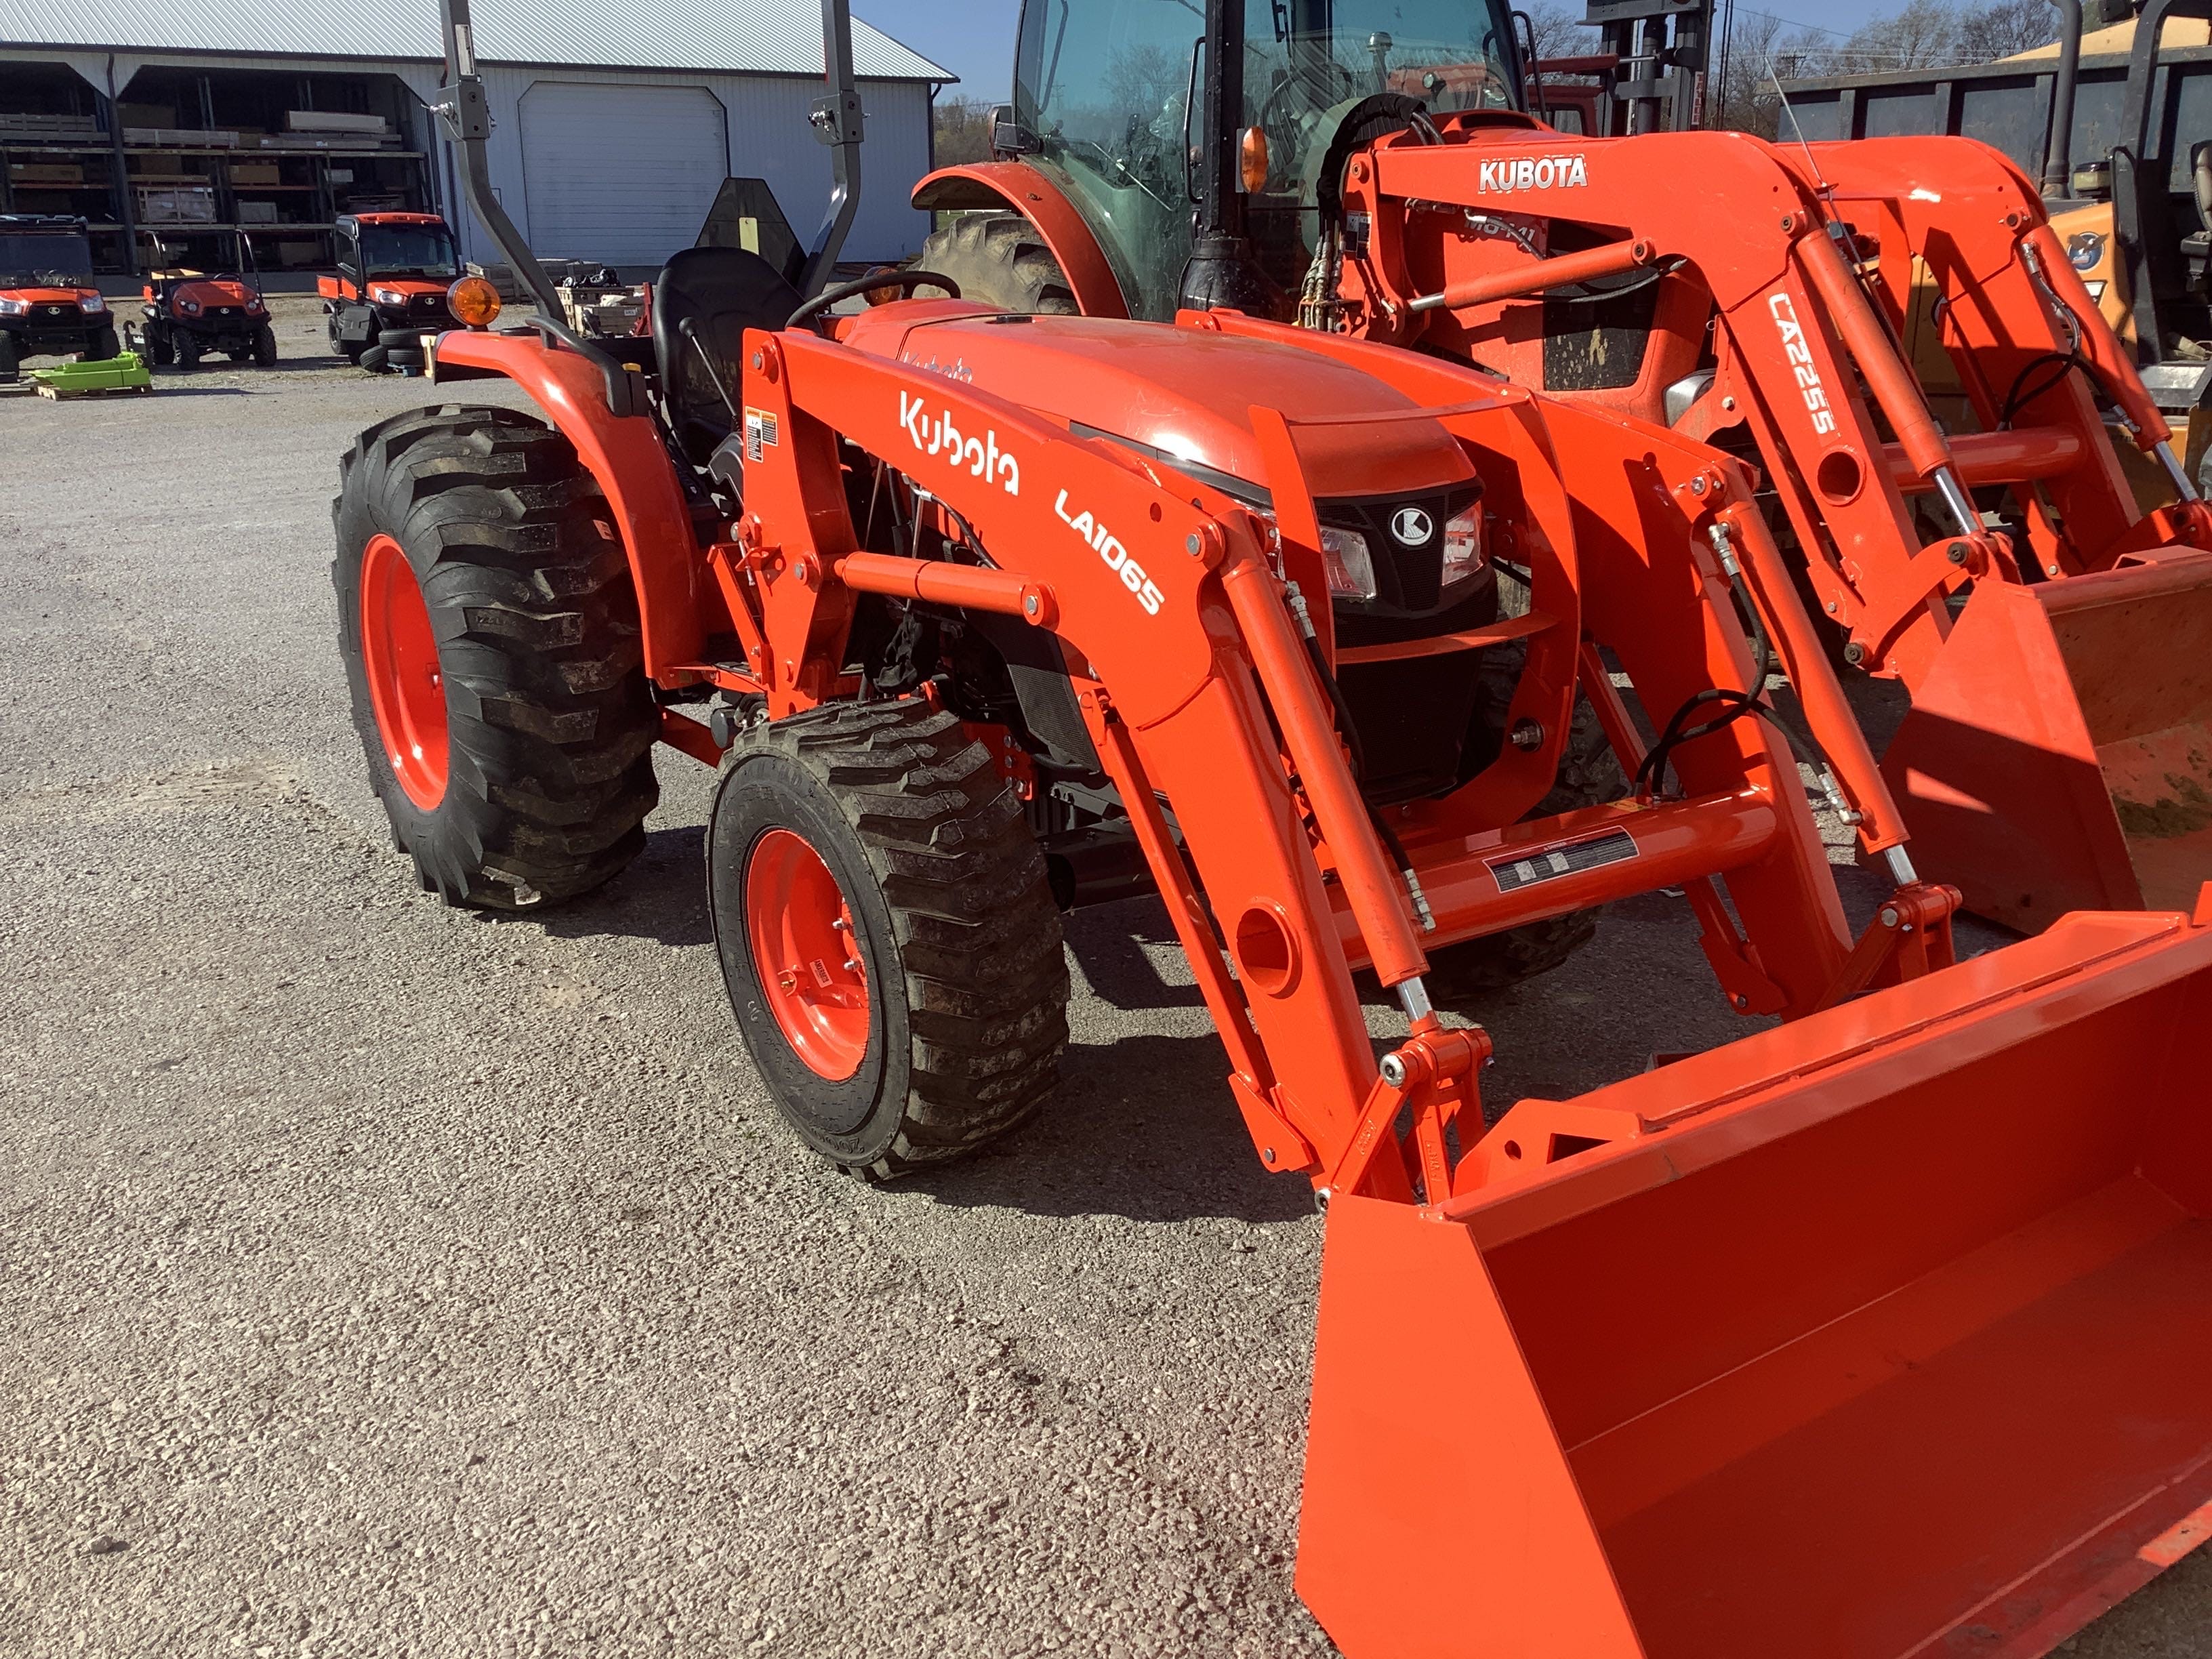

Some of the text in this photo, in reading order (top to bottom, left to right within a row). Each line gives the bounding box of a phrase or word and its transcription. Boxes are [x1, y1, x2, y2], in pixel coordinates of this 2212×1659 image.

[1479, 156, 1588, 191] KUBOTA
[1769, 293, 1835, 434] LA2255
[900, 390, 1019, 496] Kubota
[1054, 489, 1165, 615] LA1065
